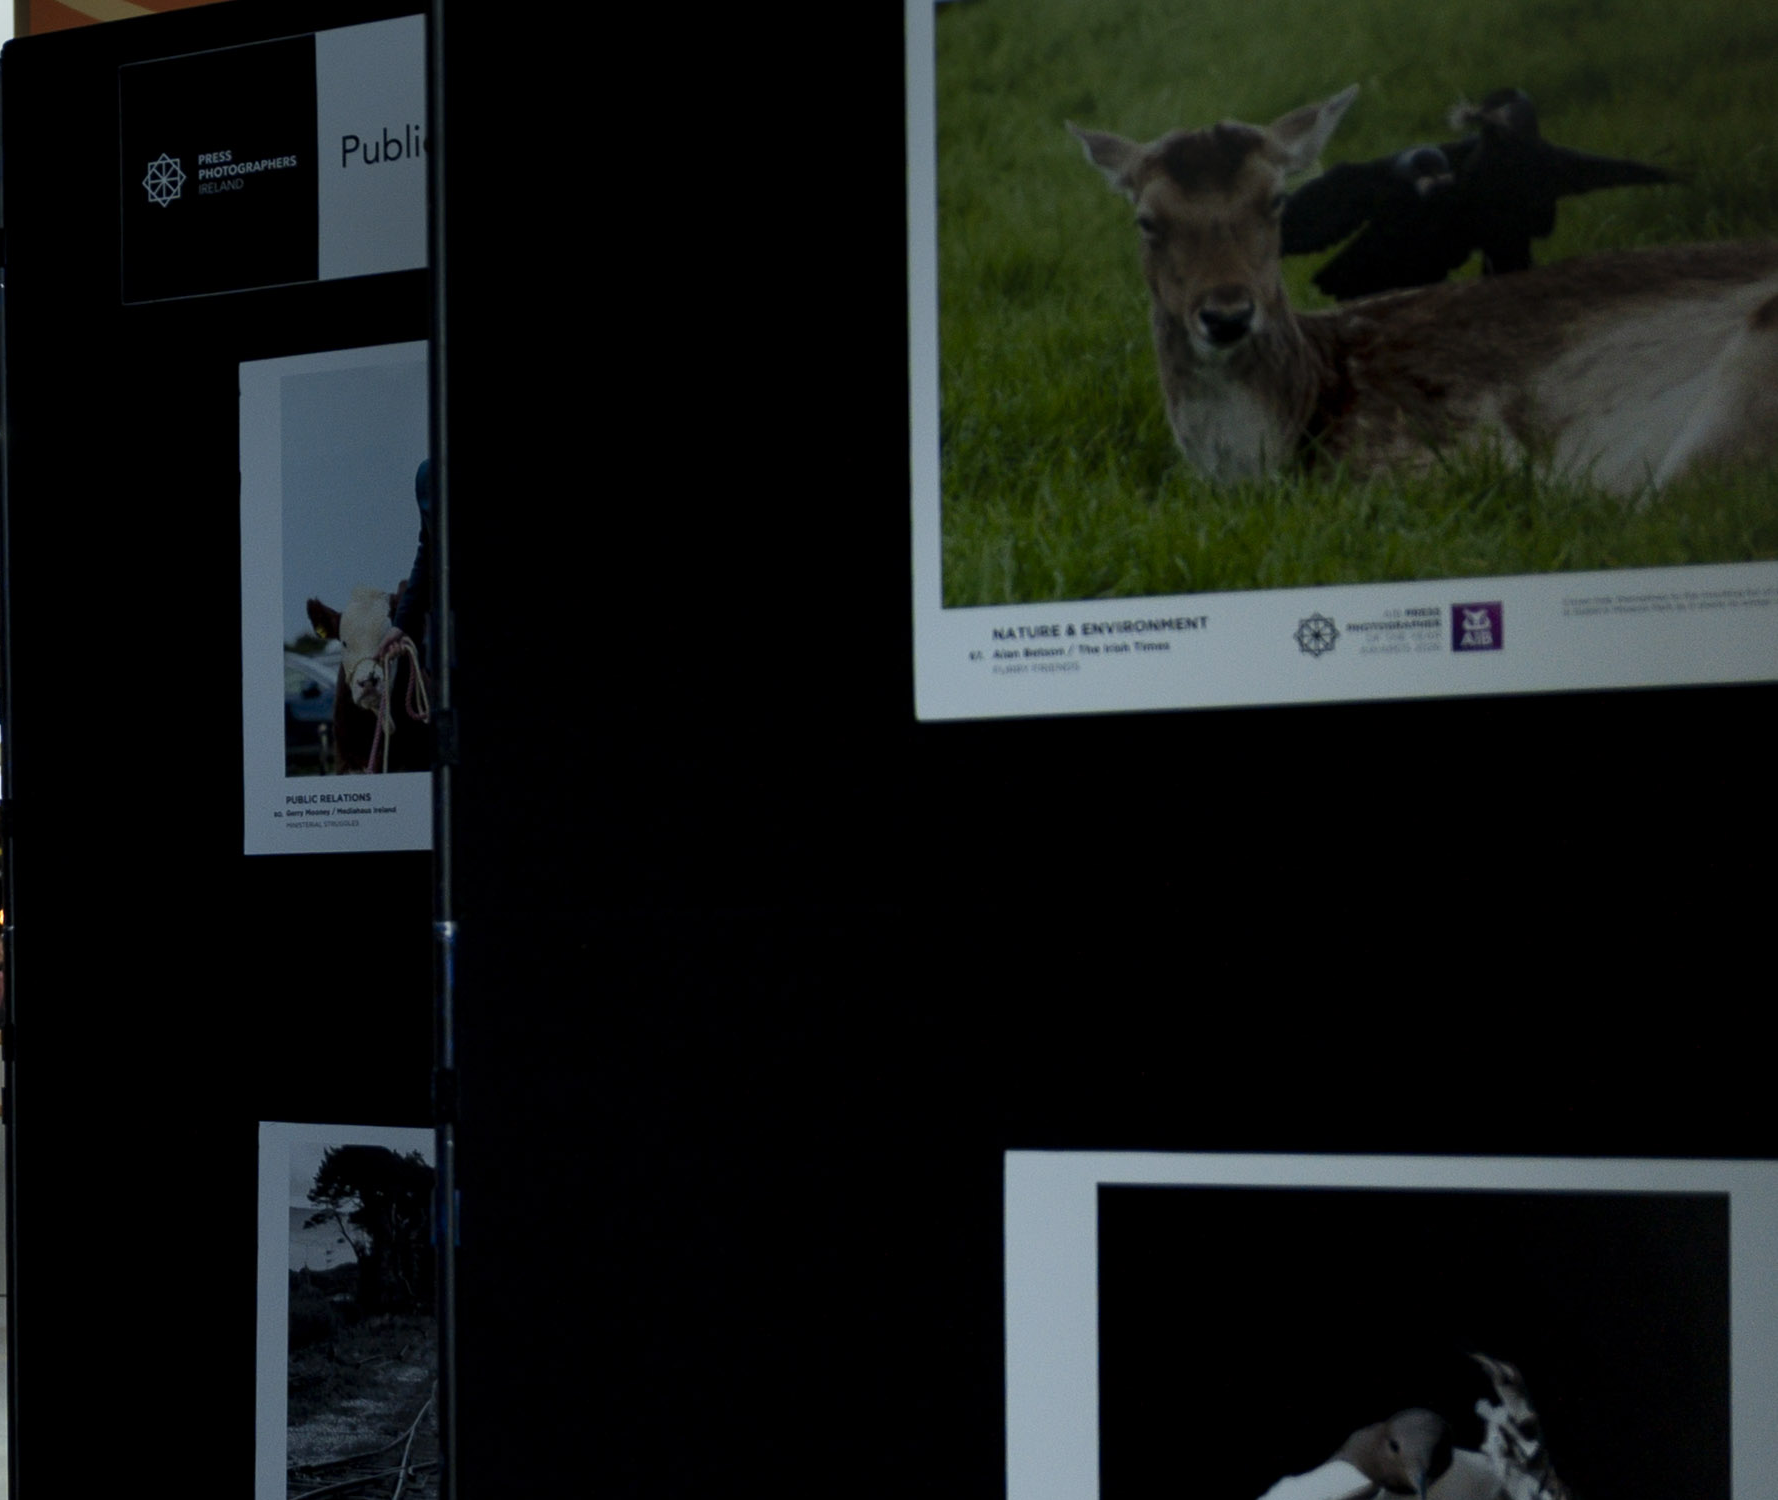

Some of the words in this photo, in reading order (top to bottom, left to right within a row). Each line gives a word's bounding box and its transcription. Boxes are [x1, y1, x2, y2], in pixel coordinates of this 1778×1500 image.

[198, 150, 233, 166] PRESS
[198, 154, 298, 181] PHOTOGRAPHERS
[198, 178, 245, 195] IRELAND
[992, 624, 1060, 641] NATURE
[1065, 623, 1076, 637] &
[1080, 615, 1208, 635] ENVIRONMENT
[286, 794, 318, 804] PUBLIC
[320, 793, 372, 803] RELATIONS
